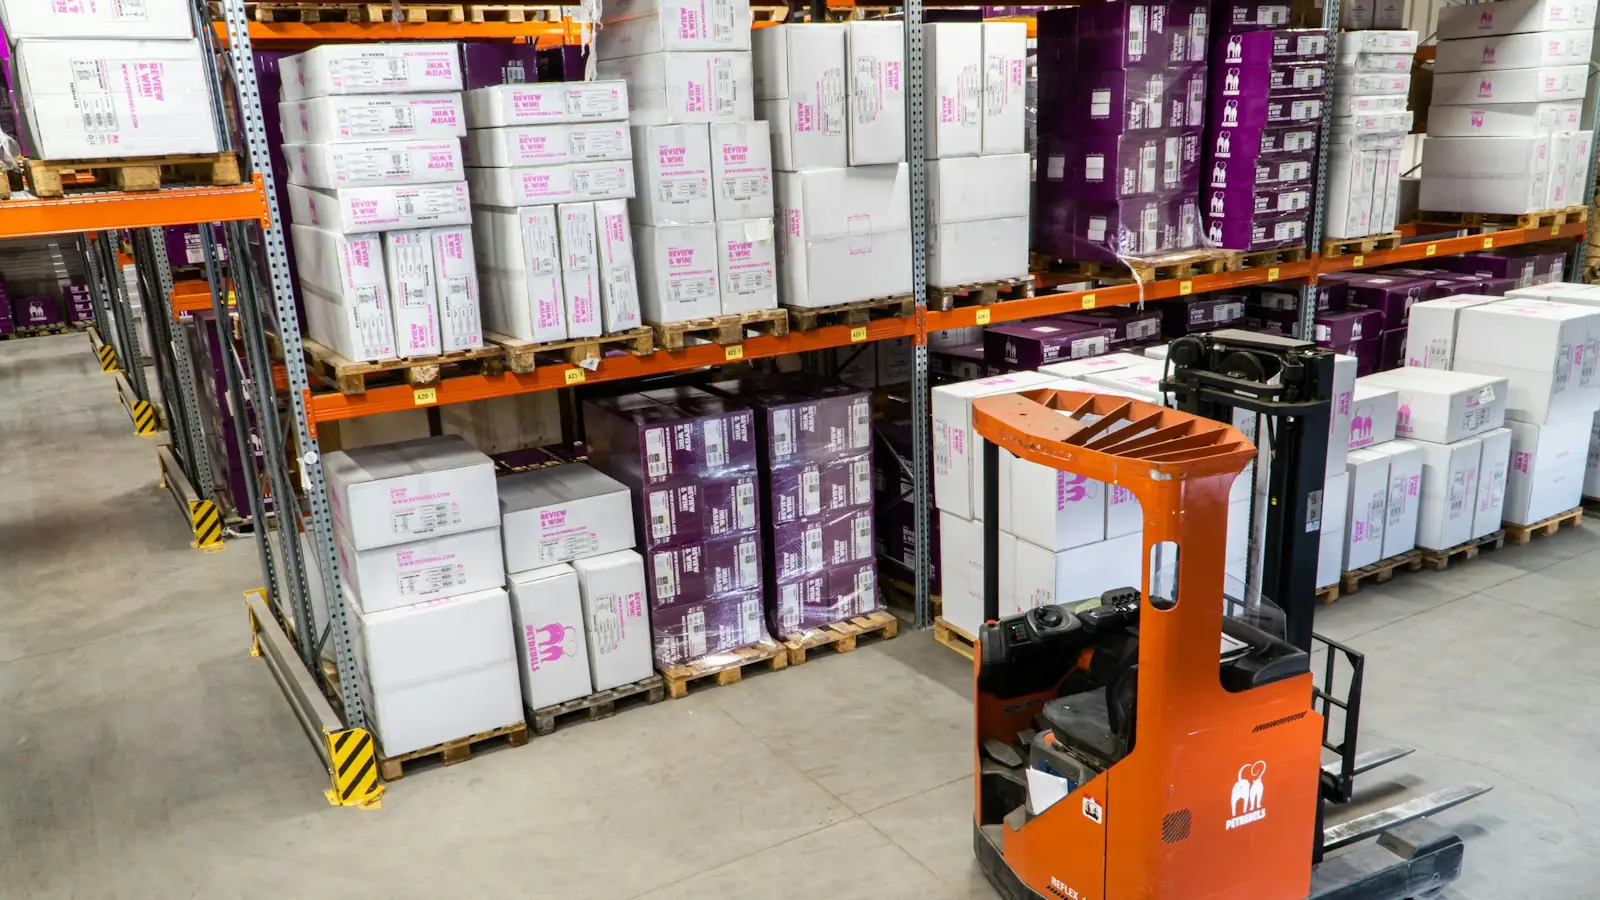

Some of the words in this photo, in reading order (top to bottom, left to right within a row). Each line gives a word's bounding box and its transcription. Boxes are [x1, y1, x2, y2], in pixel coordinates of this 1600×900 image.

[141, 72, 153, 98] WIN!
[149, 62, 164, 101] REVIEW
[668, 250, 694, 258] REVIEW
[728, 242, 752, 250] REVIEW
[684, 424, 692, 451] REVIEW
[540, 510, 567, 520] REVIEW
[548, 517, 564, 526] WIN!
[525, 624, 540, 672] PETREBELS
[1226, 808, 1266, 830] PETREBELS
[1051, 876, 1078, 900] REFLEX
